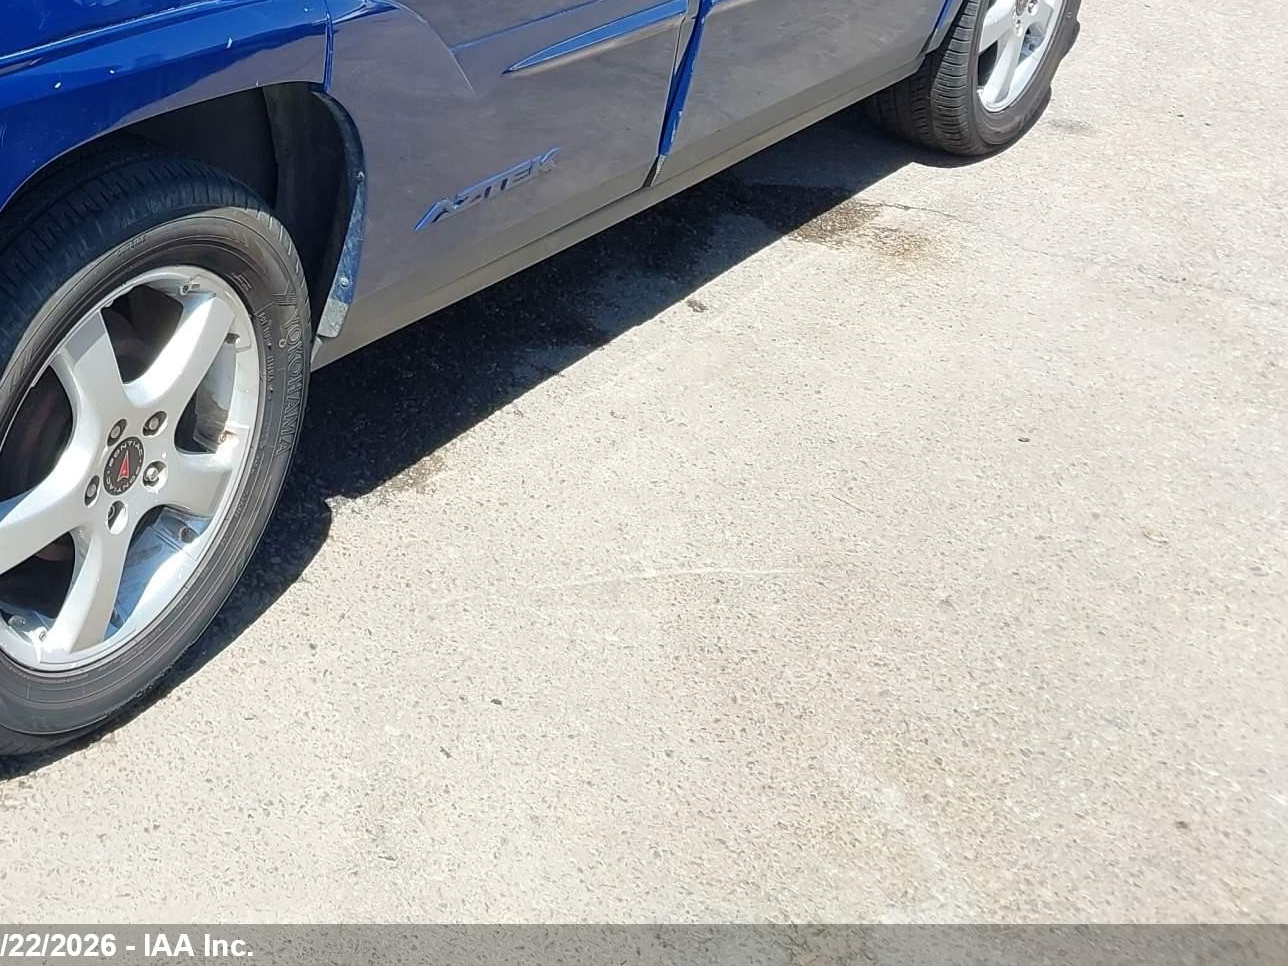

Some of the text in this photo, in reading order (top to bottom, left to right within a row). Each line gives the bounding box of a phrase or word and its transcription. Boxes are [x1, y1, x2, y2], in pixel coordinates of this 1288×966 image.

[414, 146, 561, 232] AZTEK
[274, 308, 305, 458] YOKOHAMA
[108, 440, 143, 467] PONTIAC
